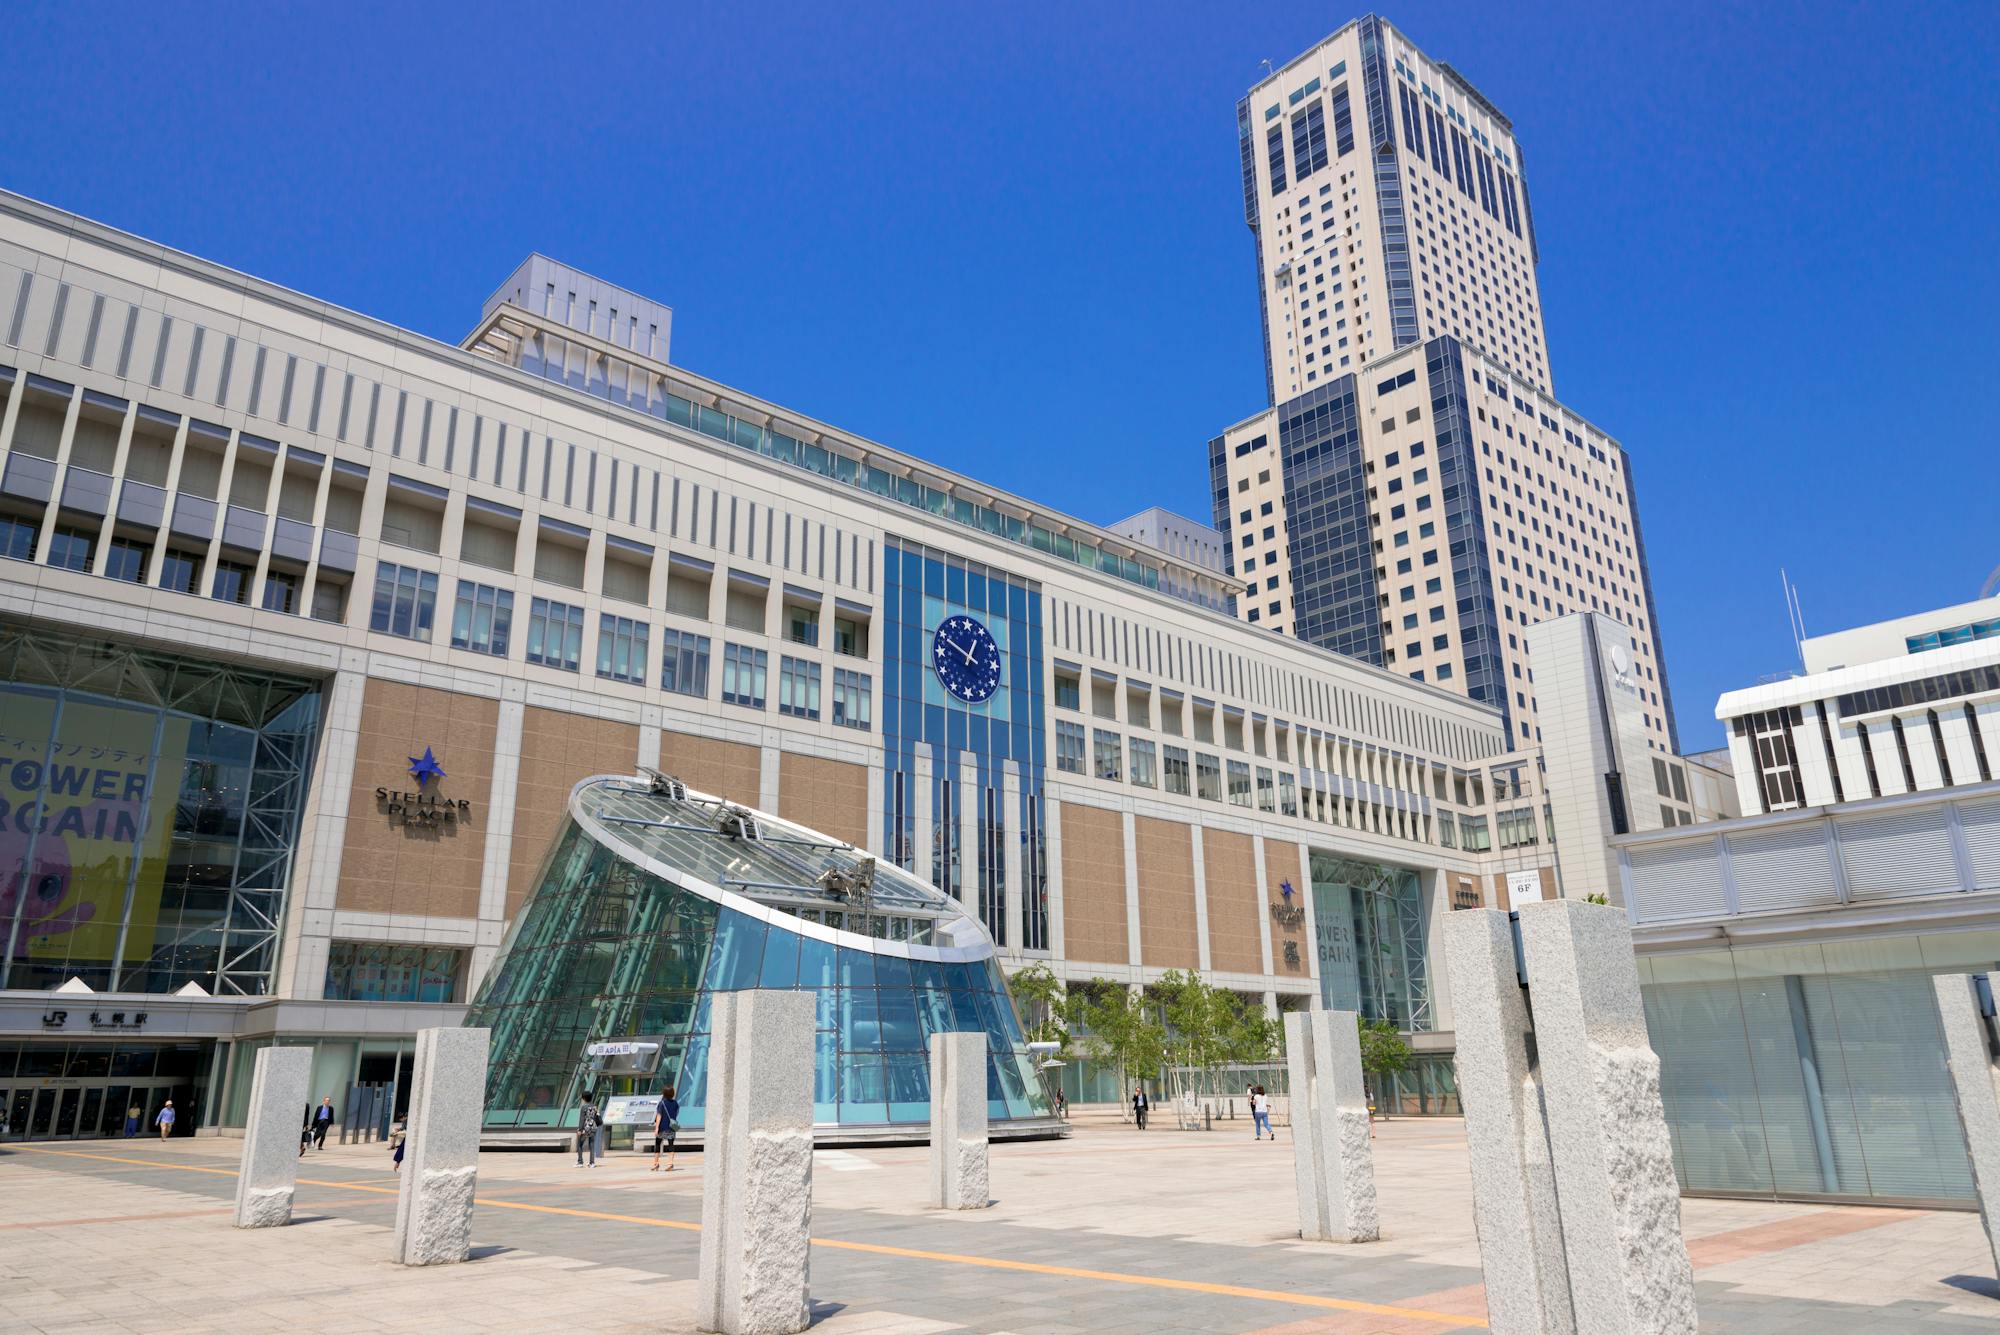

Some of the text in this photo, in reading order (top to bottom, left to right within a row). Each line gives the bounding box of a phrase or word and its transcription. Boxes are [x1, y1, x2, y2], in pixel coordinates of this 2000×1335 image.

[376, 787, 470, 809] STELLAR
[388, 804, 456, 822] PLACE
[1518, 883, 1532, 892] 6F
[42, 1011, 68, 1023] JR
